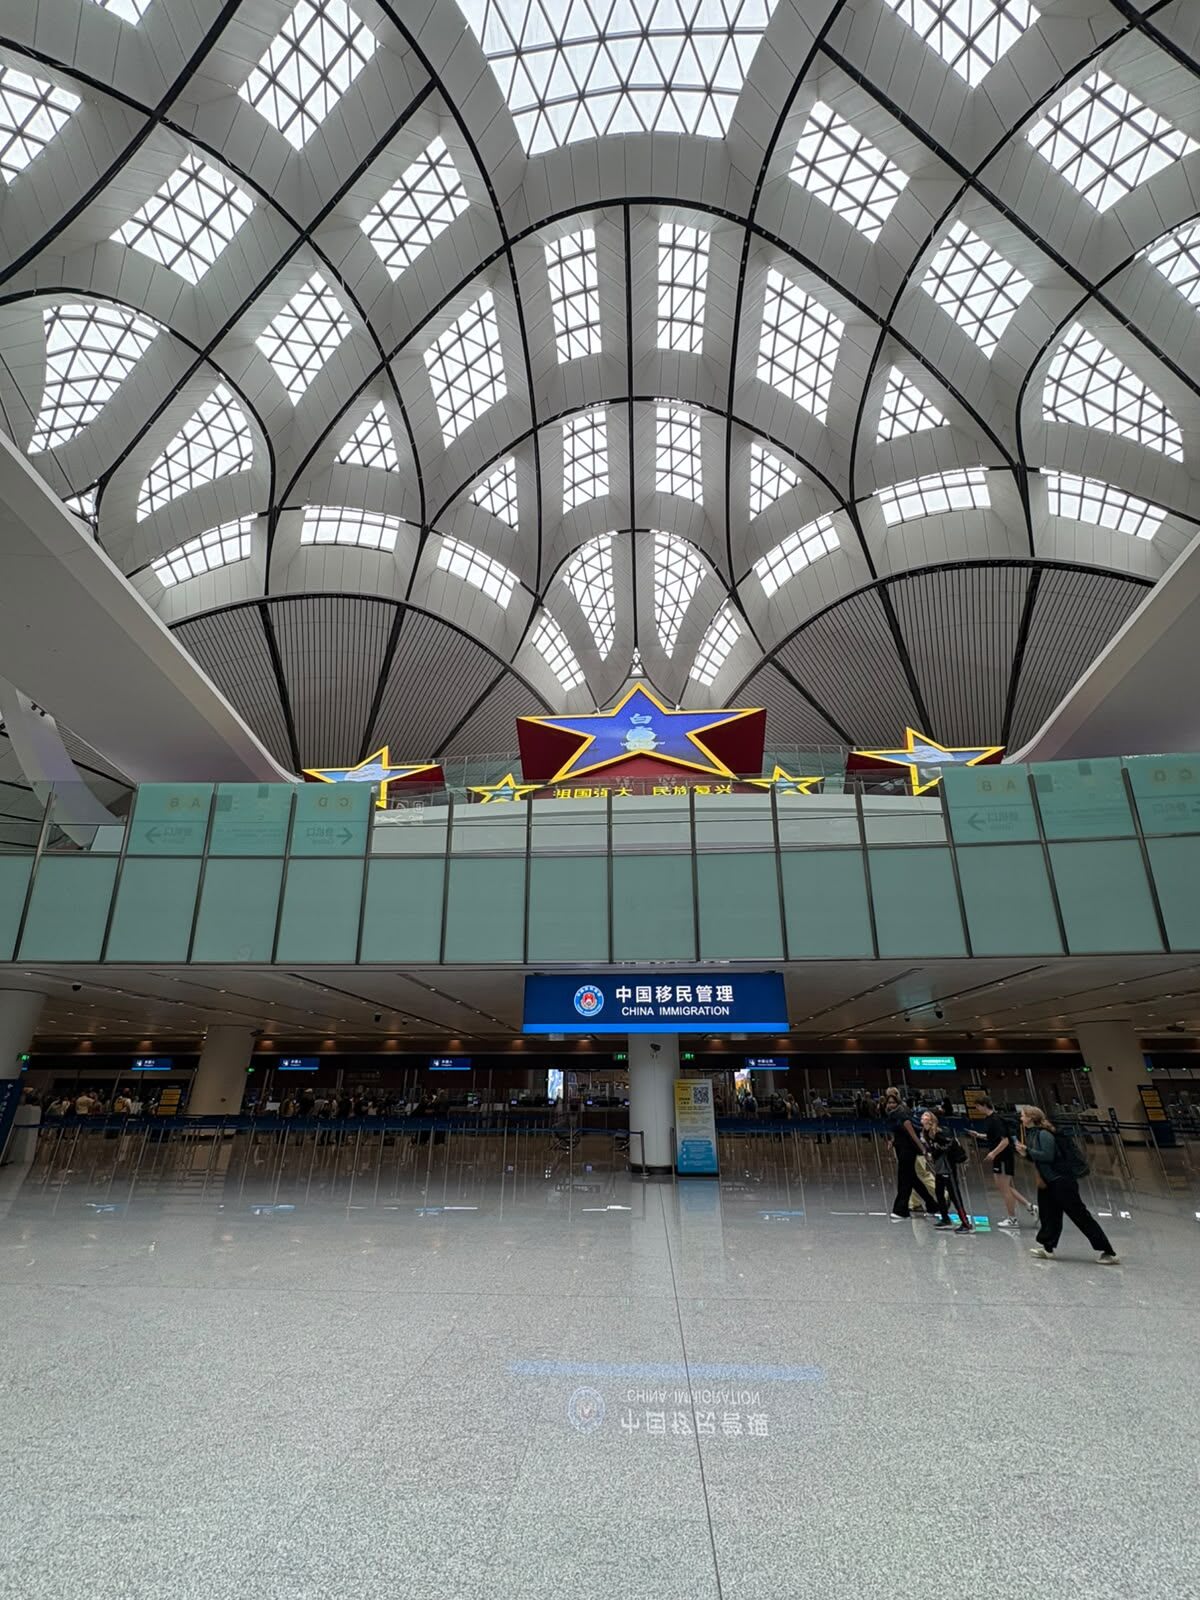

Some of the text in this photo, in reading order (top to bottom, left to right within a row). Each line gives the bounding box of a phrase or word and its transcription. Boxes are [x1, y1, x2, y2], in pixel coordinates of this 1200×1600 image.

[615, 985, 735, 1003] 中国移民管理
[621, 1005, 730, 1016] CHINA IMMIGRATION
